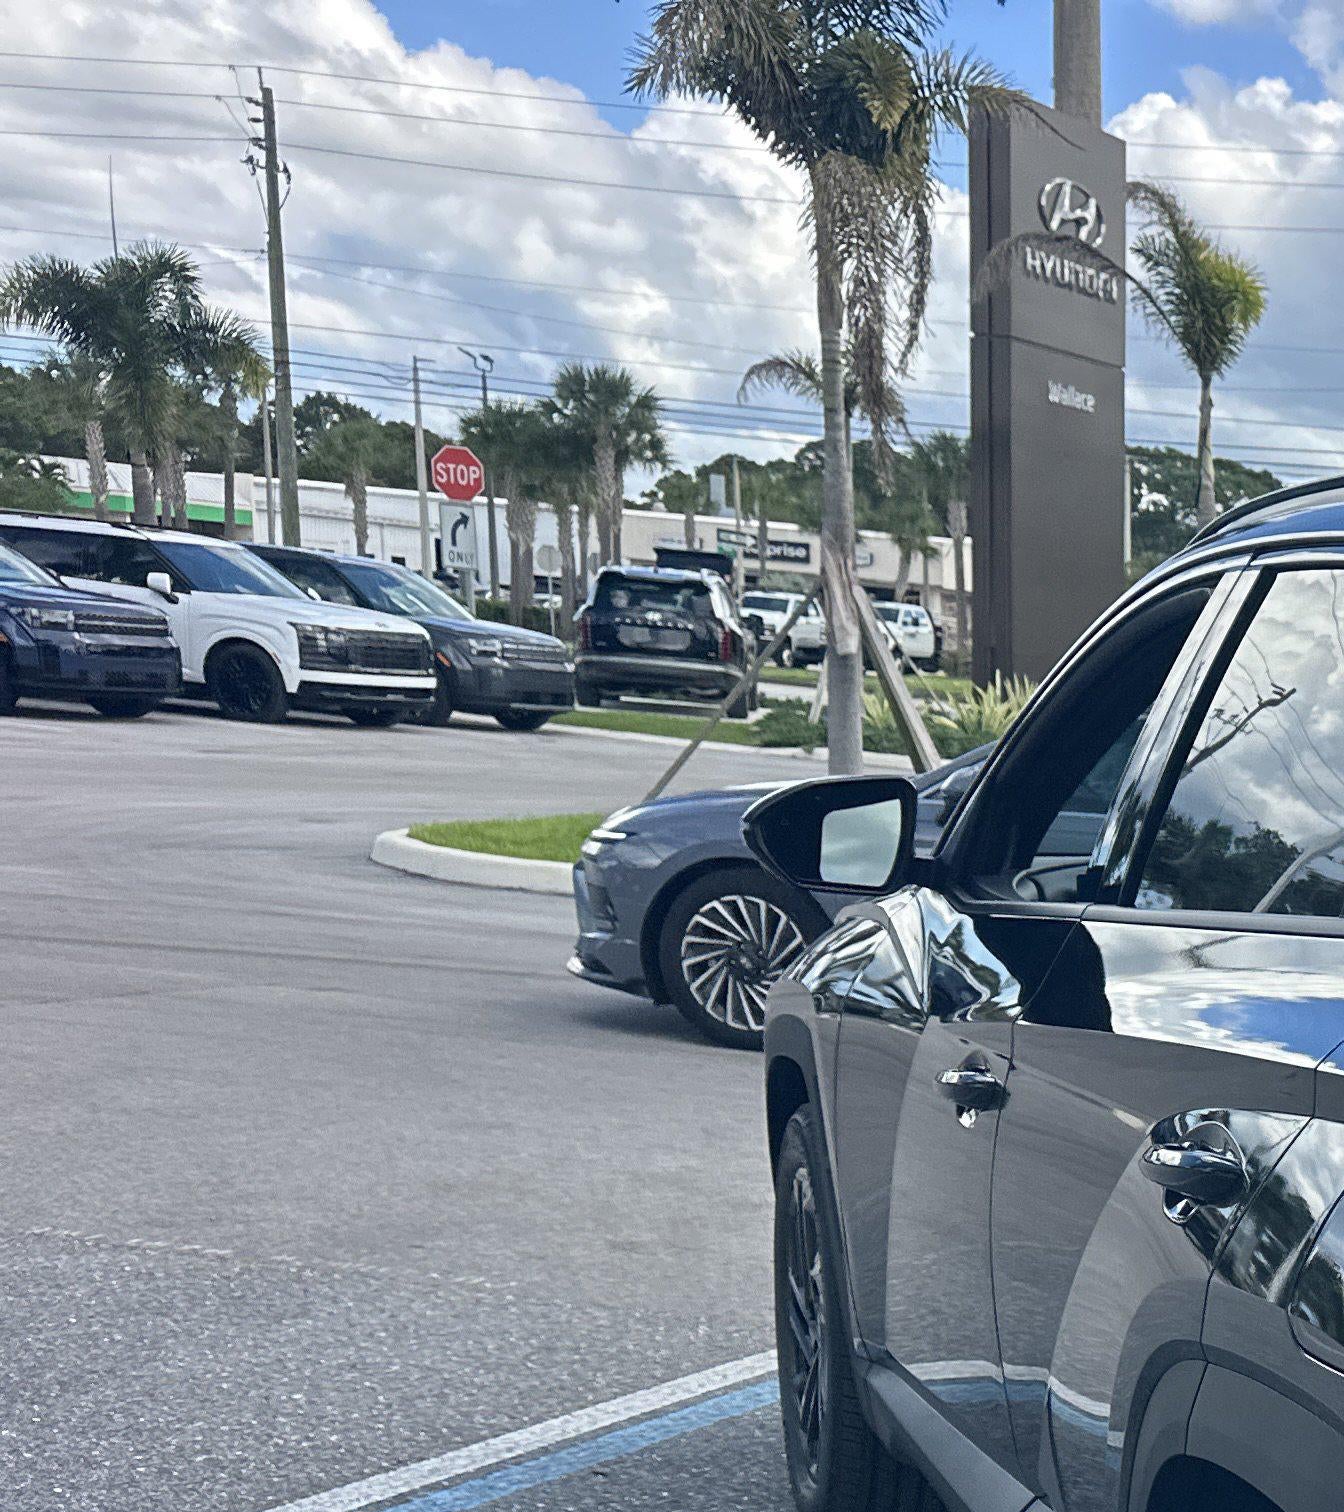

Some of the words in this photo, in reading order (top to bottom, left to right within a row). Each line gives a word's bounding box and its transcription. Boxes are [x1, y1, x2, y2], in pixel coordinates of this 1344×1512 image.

[1025, 247, 1118, 301] HYUNDAI
[436, 463, 480, 486] STOP
[448, 550, 474, 565] ONLY
